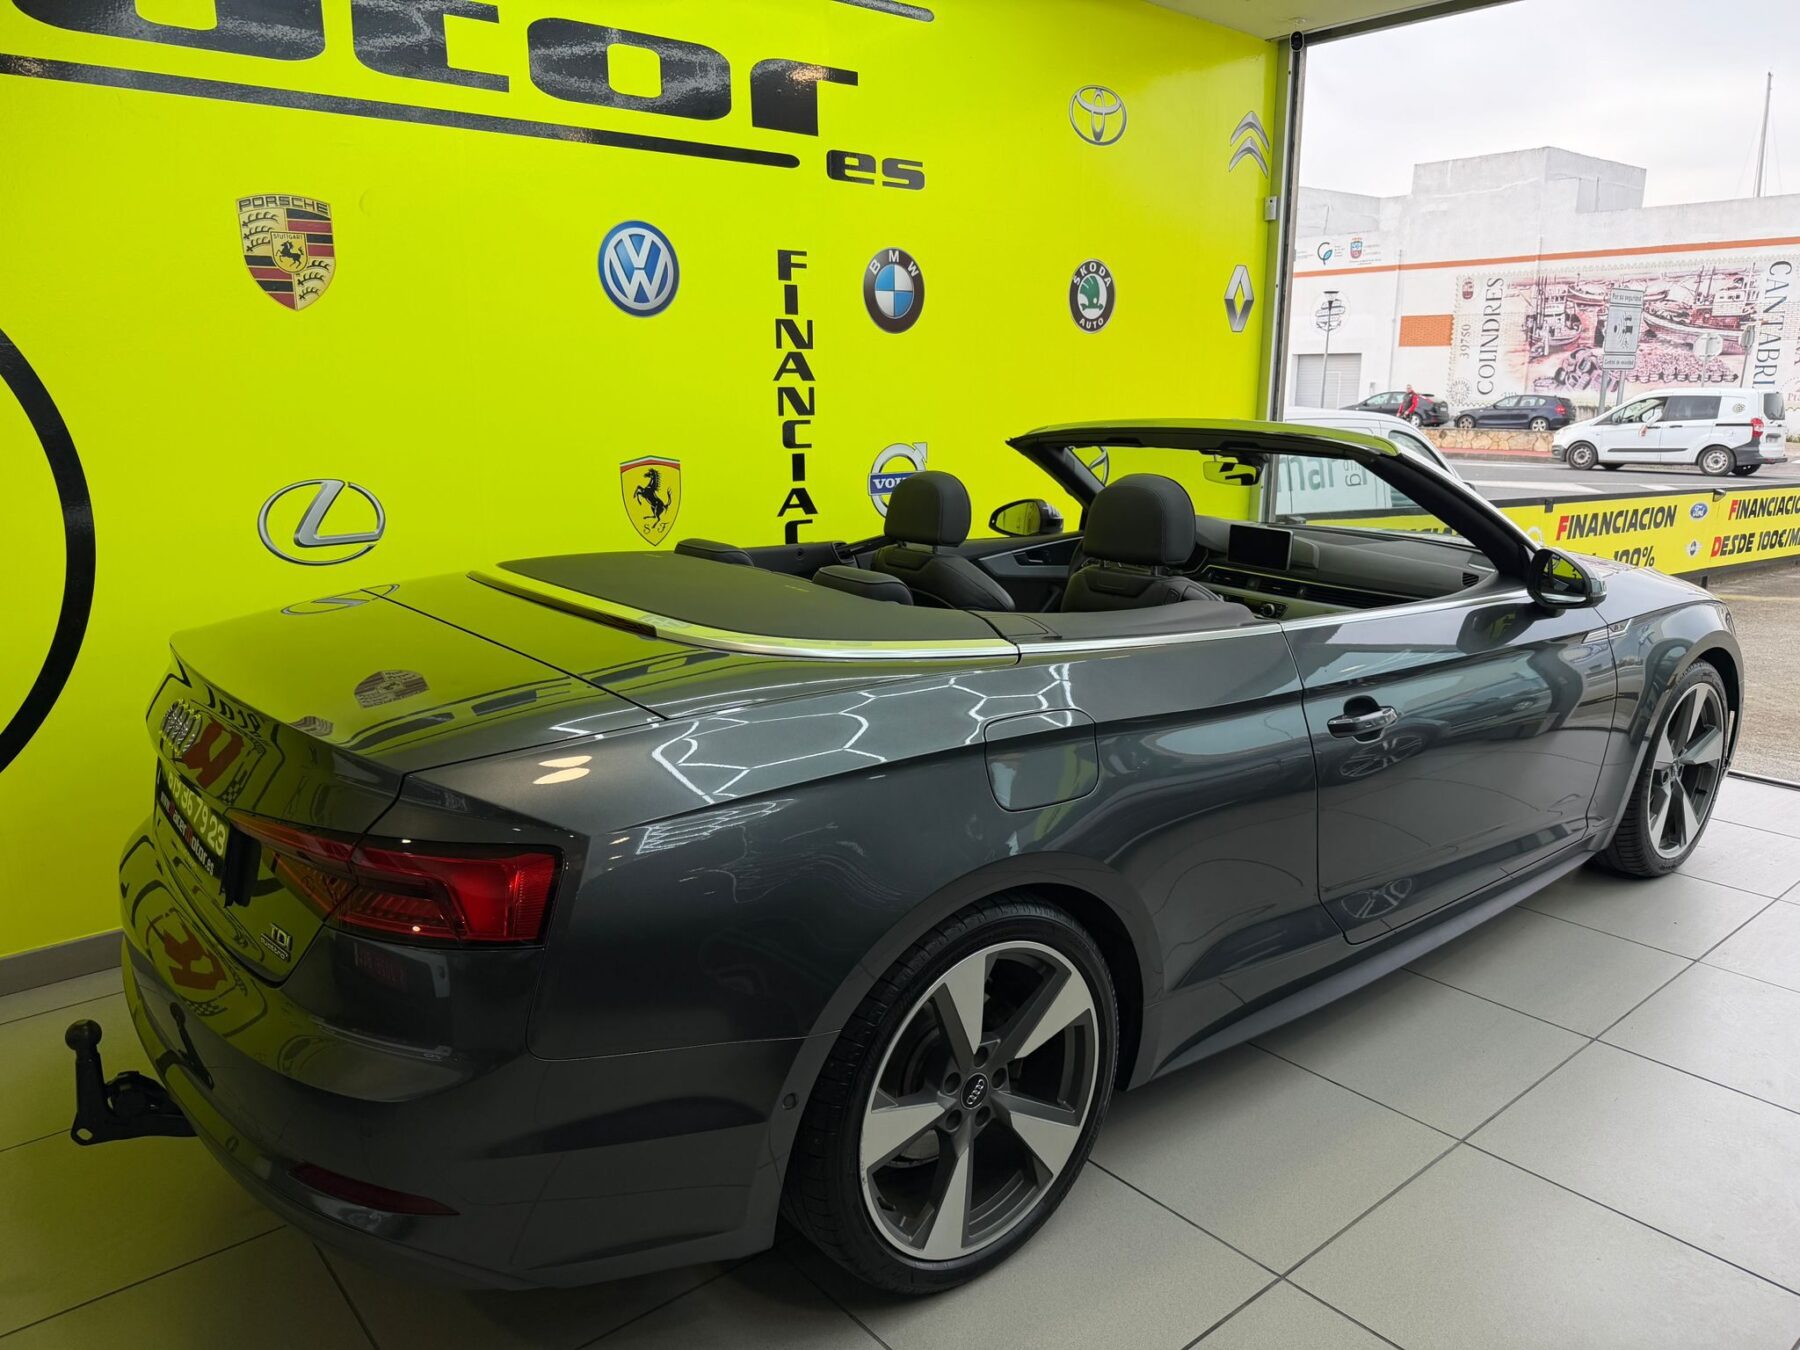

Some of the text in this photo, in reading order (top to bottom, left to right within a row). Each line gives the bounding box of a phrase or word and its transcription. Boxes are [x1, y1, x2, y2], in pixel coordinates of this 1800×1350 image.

[826, 149, 925, 191] es
[238, 195, 330, 216] PORSCHE
[869, 250, 920, 277] BMW
[1079, 318, 1104, 329] AUTO
[1476, 277, 1505, 396] COLINDRES
[1752, 260, 1793, 389] CANTABRI
[1555, 504, 1678, 541] FINANCIACION
[1711, 527, 1800, 558] DESDE 100€/M
[193, 796, 209, 834] 79
[207, 814, 226, 857] 23
